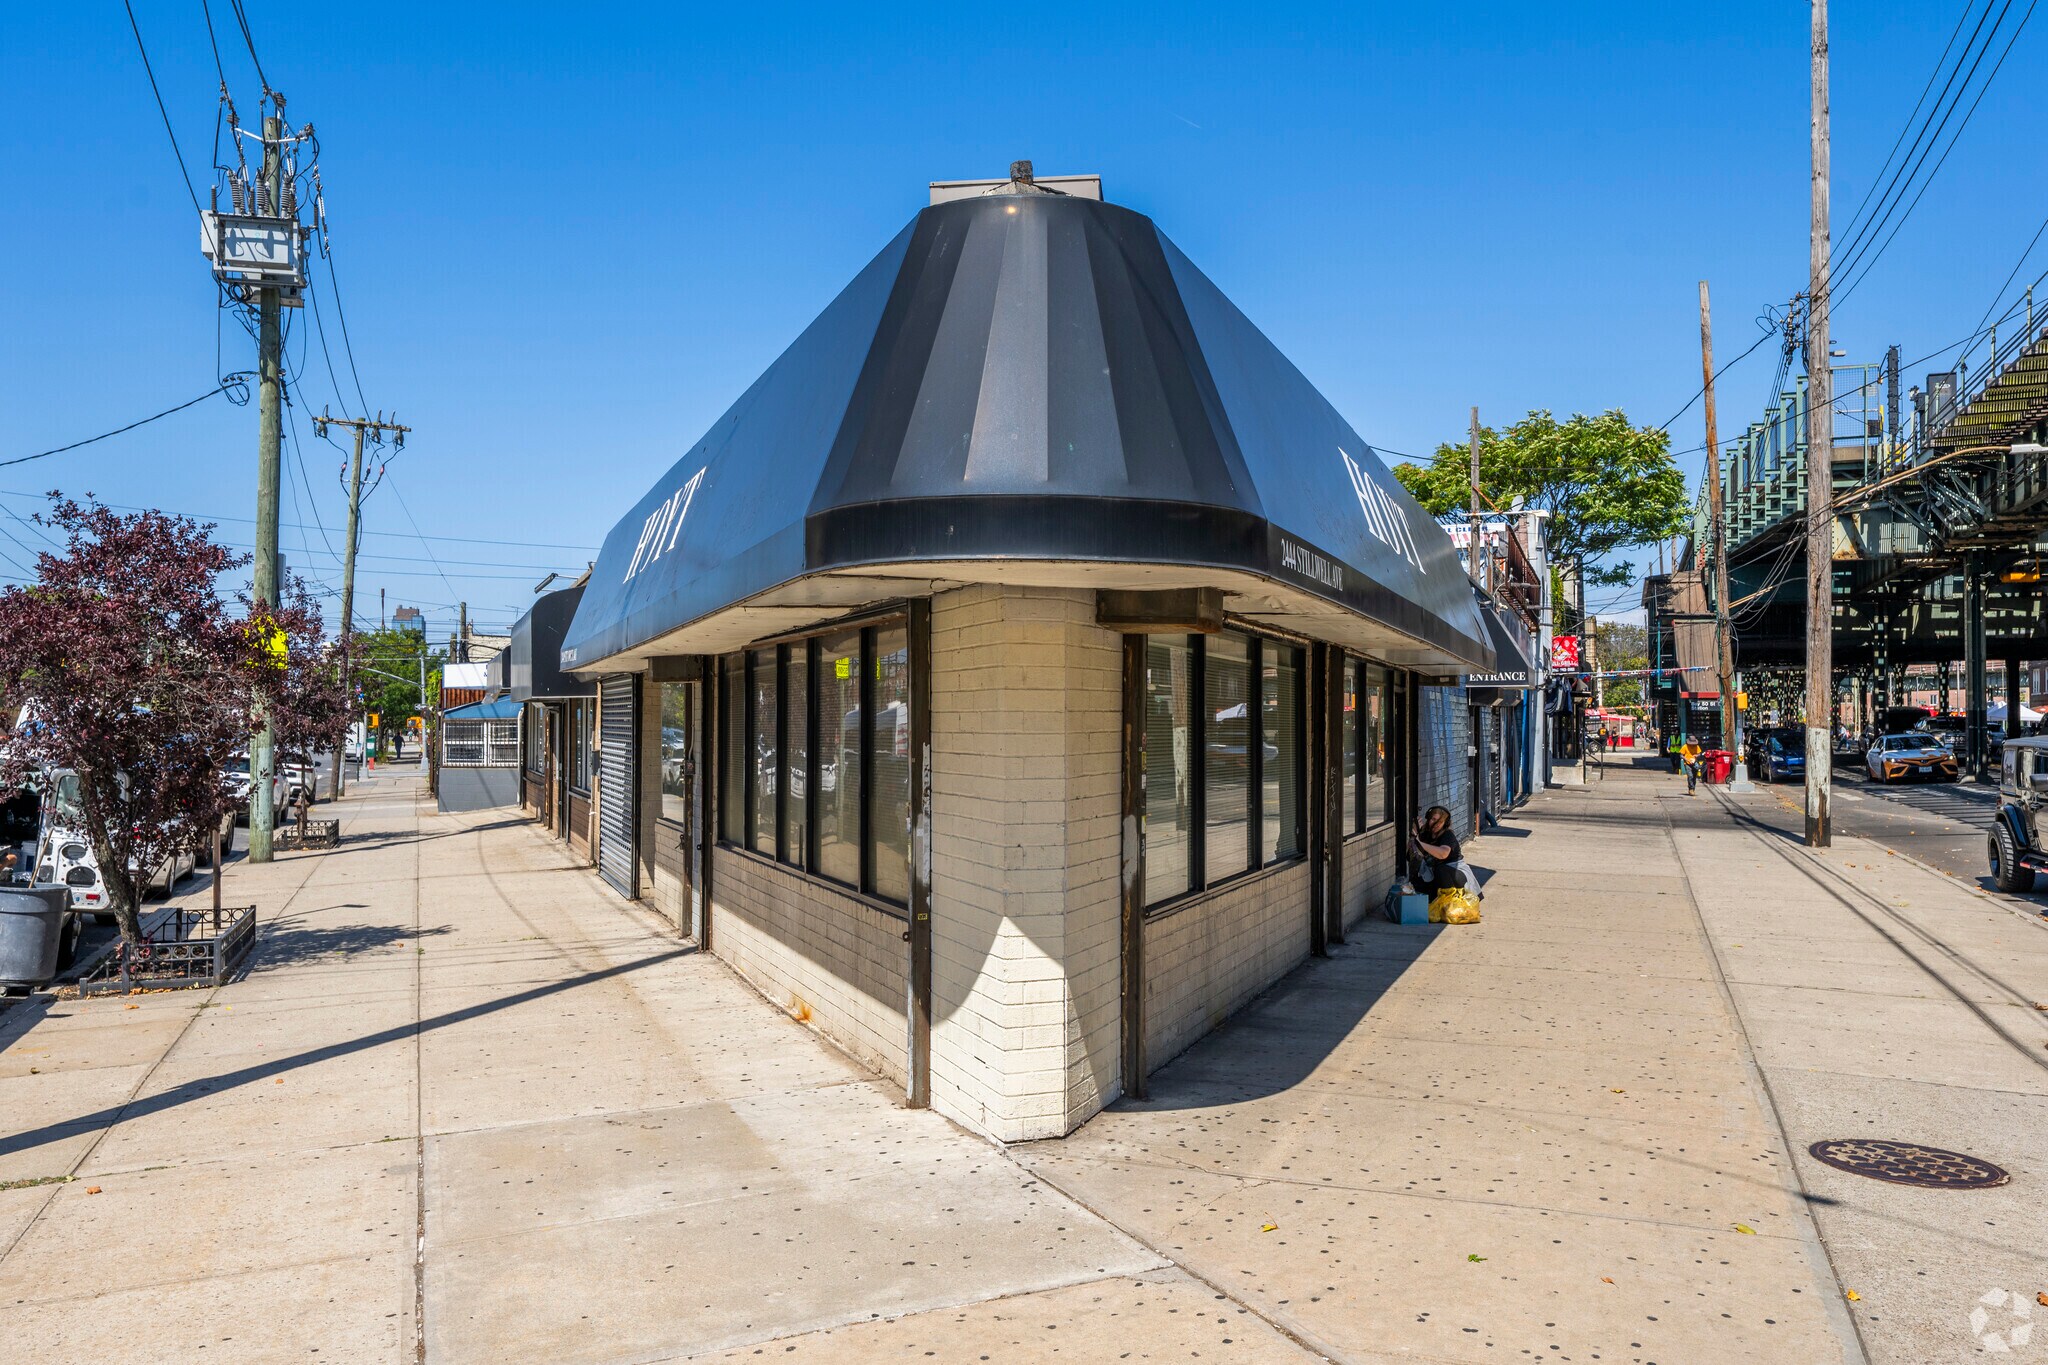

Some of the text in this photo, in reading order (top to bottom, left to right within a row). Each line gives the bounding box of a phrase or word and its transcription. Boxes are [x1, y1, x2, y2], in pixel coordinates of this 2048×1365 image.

[623, 466, 706, 584] HOYT
[1338, 446, 1427, 575] HOYT
[1281, 538, 1343, 592] 2444 STILLWELL AVE
[1469, 671, 1526, 682] ENTRANCE
